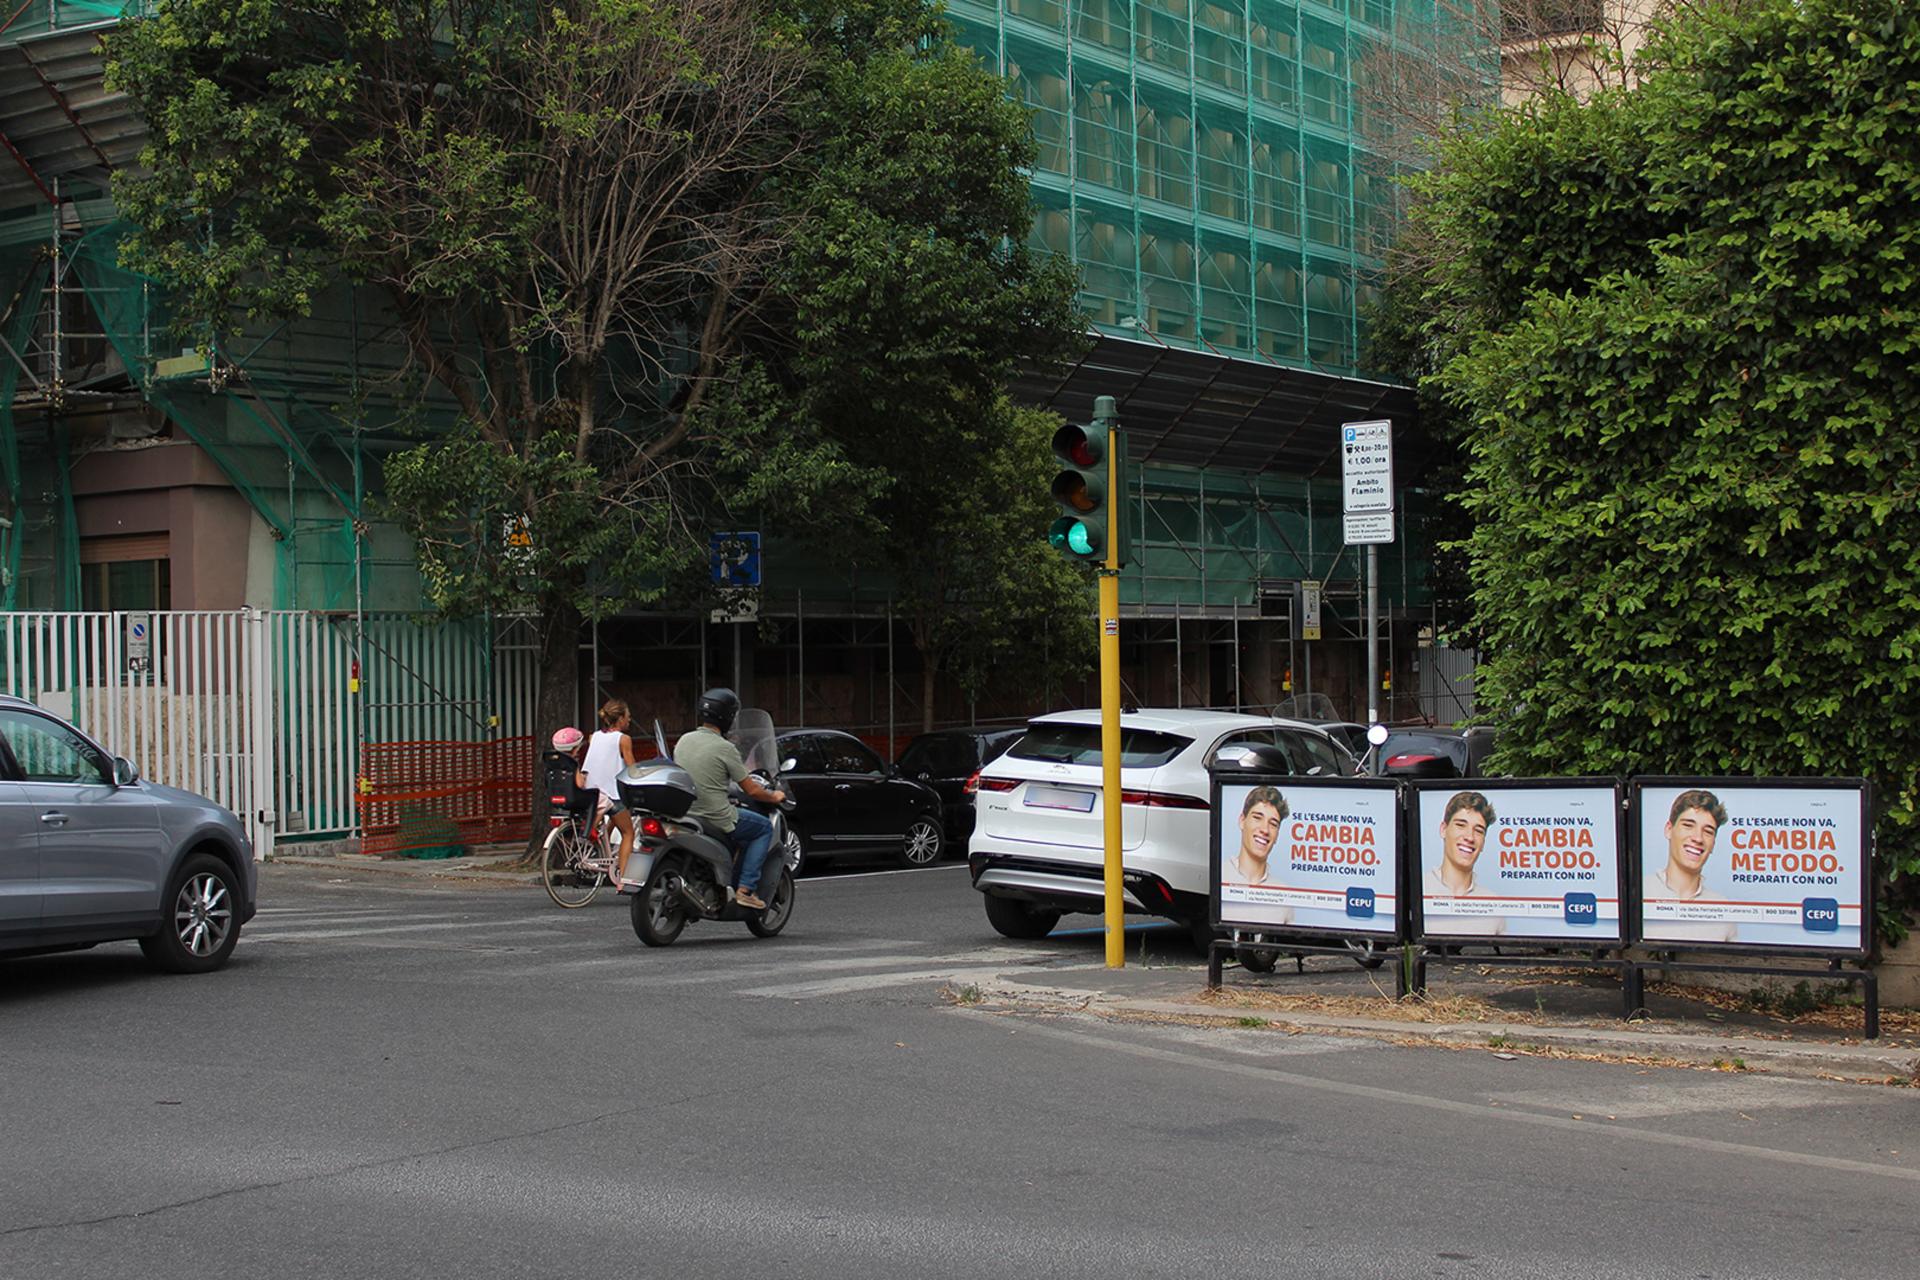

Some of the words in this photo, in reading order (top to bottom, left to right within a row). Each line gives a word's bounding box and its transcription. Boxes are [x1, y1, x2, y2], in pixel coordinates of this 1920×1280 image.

[1352, 486, 1384, 495] Flaminio
[1292, 812, 1301, 820] SE
[1304, 813, 1339, 822] L'ESAME
[1340, 815, 1360, 824] NON
[1361, 816, 1376, 825] VA,
[1500, 817, 1511, 826] SE
[1513, 817, 1551, 826] L'ESAME
[1553, 818, 1575, 826] NON
[1577, 818, 1593, 826] VA,
[1732, 817, 1743, 826] SE
[1747, 818, 1789, 826] L'ESAME
[1792, 818, 1816, 827] NON
[1818, 819, 1836, 828] VA,
[1291, 823, 1375, 845] CAMBIA
[1499, 828, 1593, 848] CAMBIA
[1731, 829, 1836, 850] CAMBIA
[1291, 844, 1381, 865] METODO.
[1500, 851, 1601, 869] METODO.
[1731, 853, 1844, 873] METODO.
[1291, 863, 1337, 874] PREPARATI
[1339, 866, 1358, 875] CON
[1359, 868, 1375, 876] NOI
[1501, 871, 1552, 880] PREPARATI
[1554, 871, 1575, 880] CON
[1577, 872, 1595, 880] NOI
[1732, 874, 1789, 883] PREPARATI
[1792, 875, 1814, 884] CON
[1817, 876, 1837, 884] NOI
[1349, 897, 1372, 908] CEPU
[1568, 904, 1594, 913] CEPU
[1806, 909, 1834, 919] CEPU
